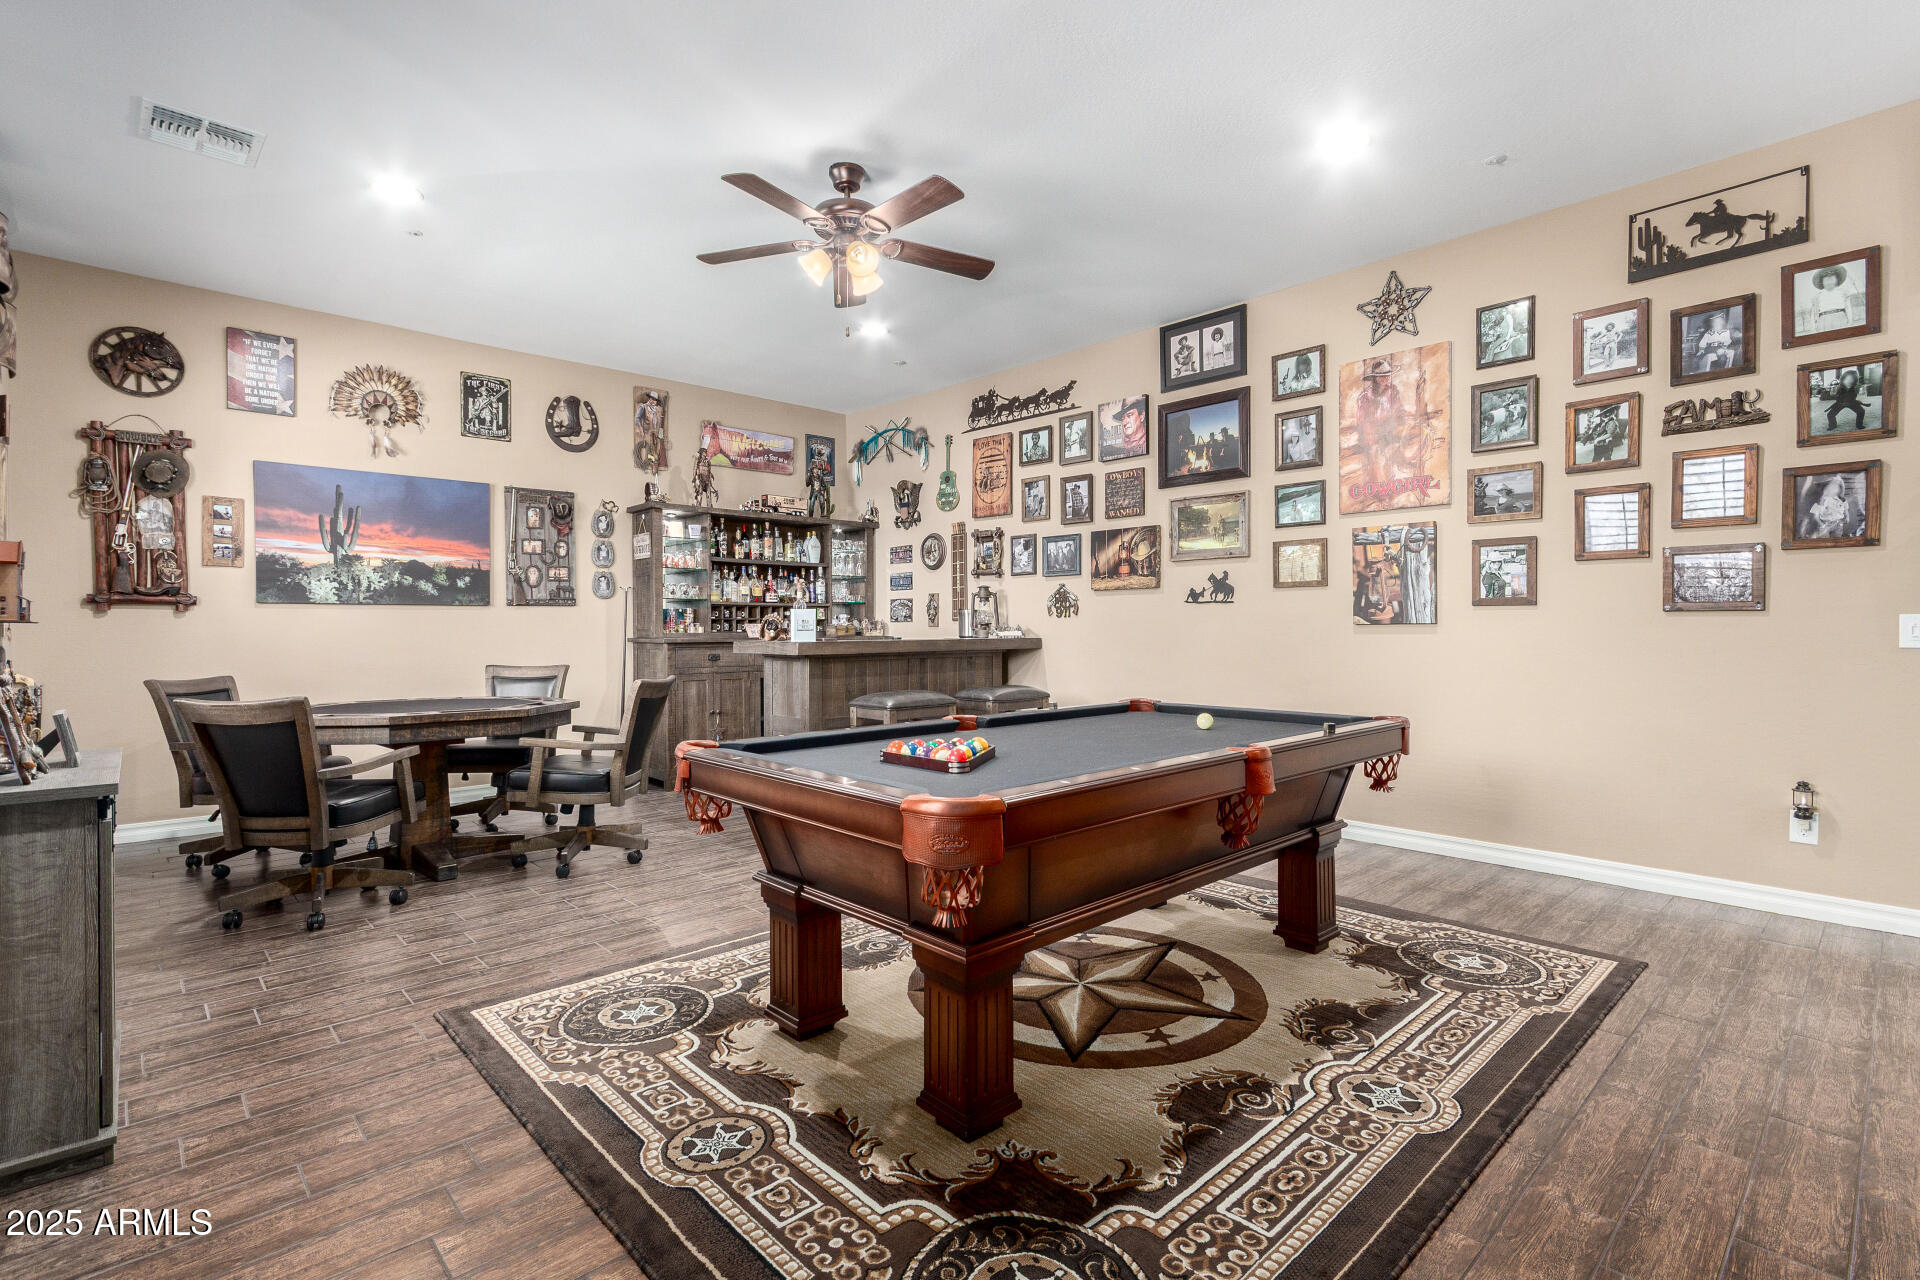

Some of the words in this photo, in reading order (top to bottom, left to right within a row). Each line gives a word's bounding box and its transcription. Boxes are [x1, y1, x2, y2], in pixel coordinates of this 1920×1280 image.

[251, 348, 272, 357] FORGET
[246, 355, 259, 363] THAT
[1105, 469, 1143, 481] COWBOYS
[1349, 474, 1441, 499] COWGIRL
[1108, 507, 1141, 518] WANTED
